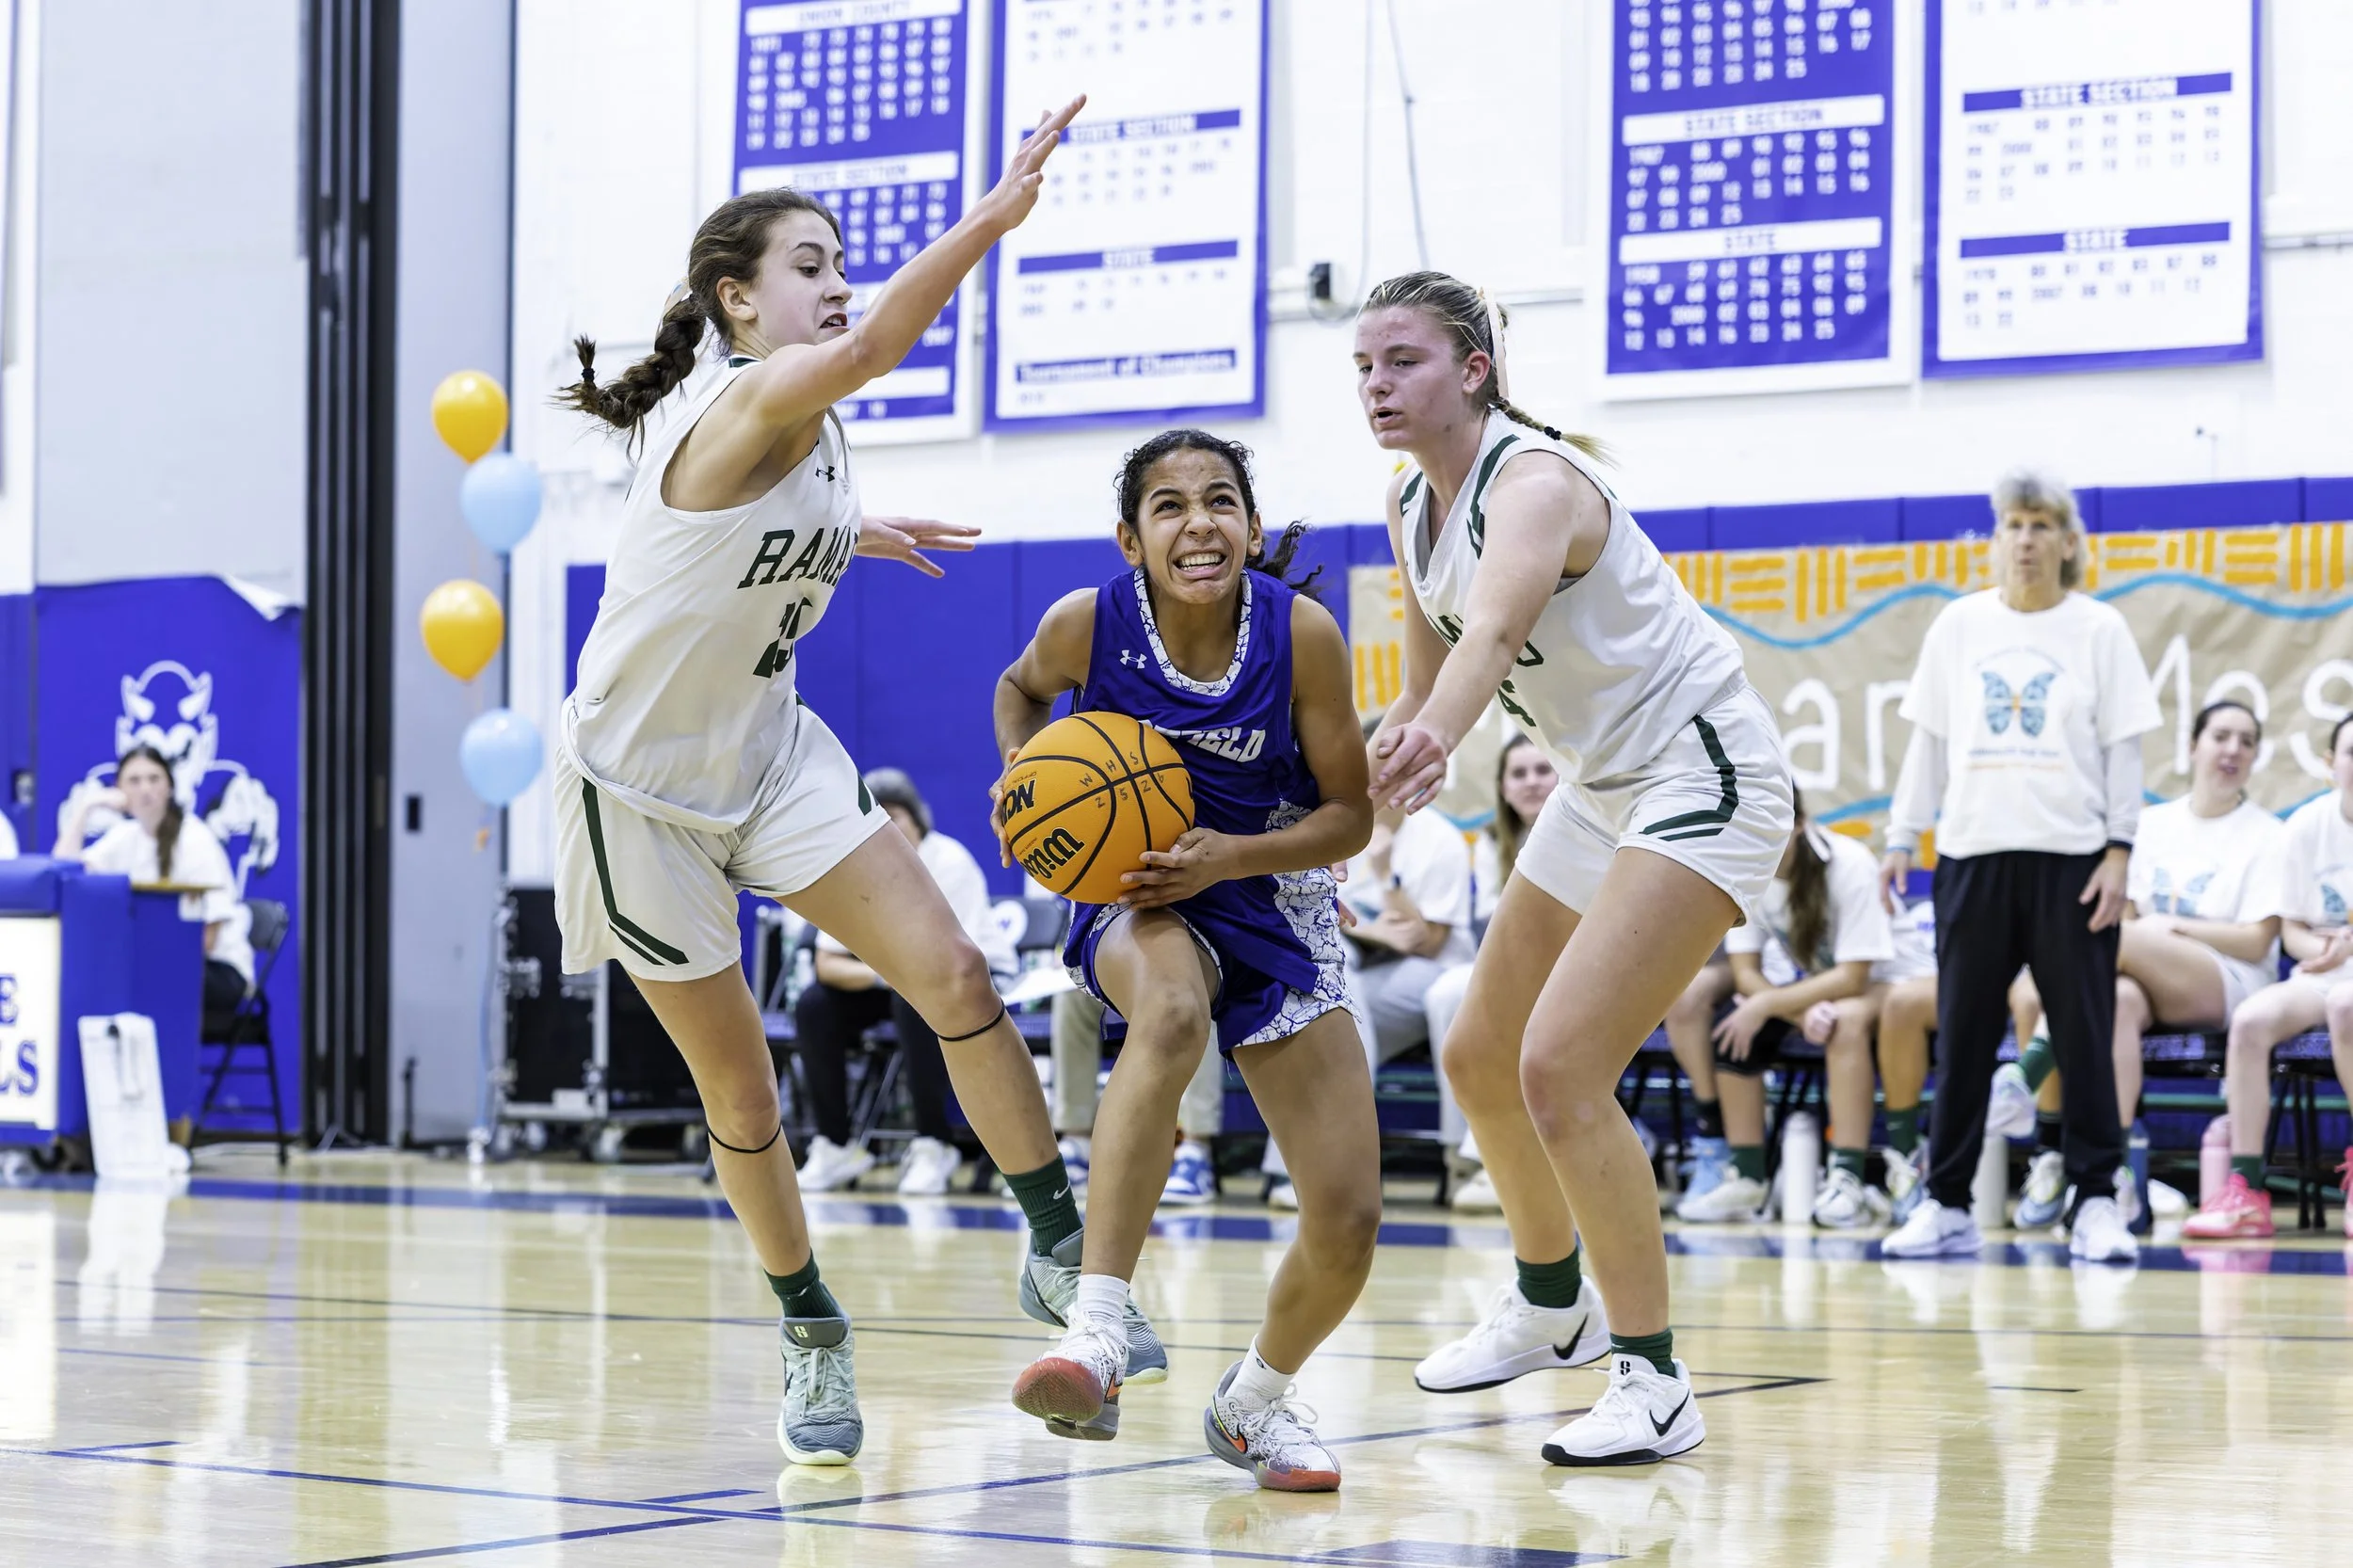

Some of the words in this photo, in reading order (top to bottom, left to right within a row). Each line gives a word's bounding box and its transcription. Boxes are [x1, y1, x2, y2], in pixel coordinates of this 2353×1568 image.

[2022, 87, 2083, 108] STATE
[2088, 76, 2178, 103] SECTION
[2064, 228, 2128, 252] STATE
